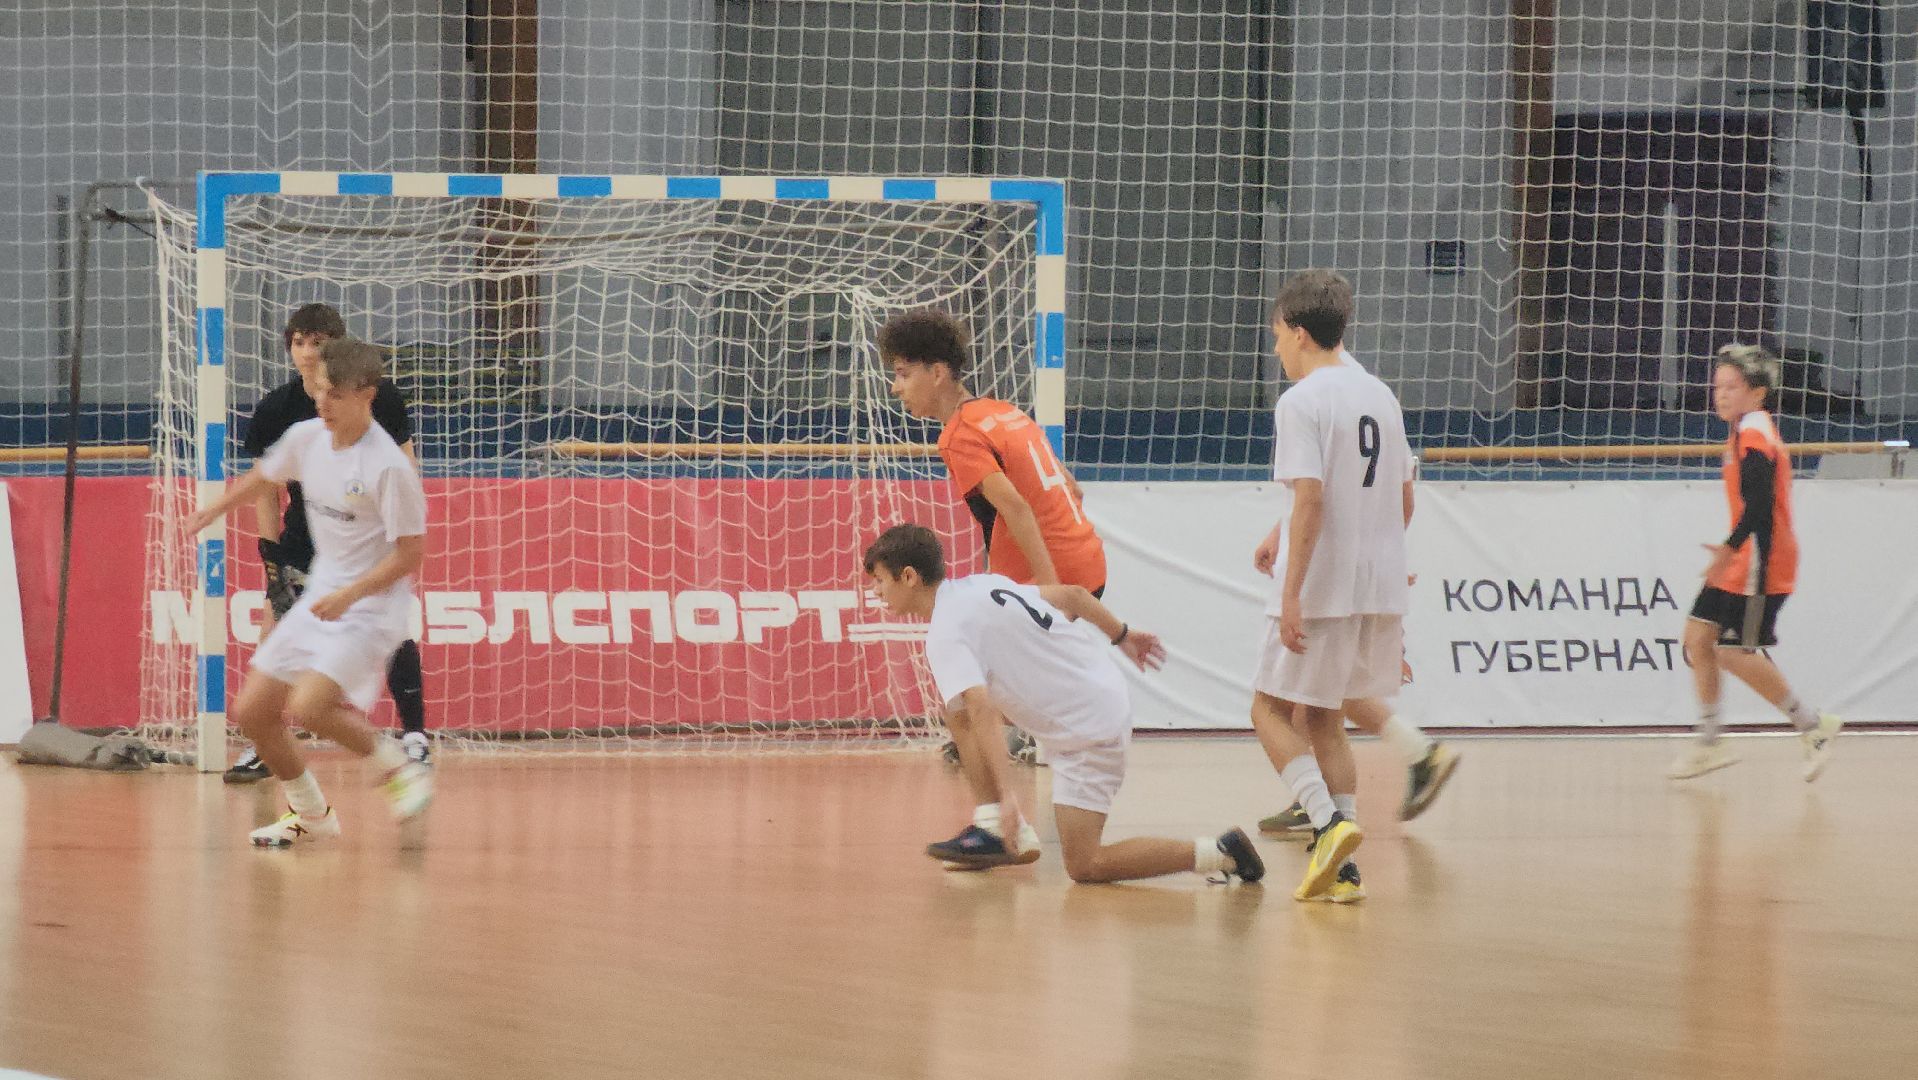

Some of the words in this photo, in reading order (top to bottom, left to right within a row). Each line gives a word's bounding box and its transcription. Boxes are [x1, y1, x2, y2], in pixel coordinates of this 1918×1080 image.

[1359, 414, 1381, 488] 9
[1027, 435, 1082, 525] 4
[150, 590, 858, 644] МОБЛСПОРТ
[990, 588, 1053, 631] 2
[1443, 577, 1679, 616] КОМАНДА
[1450, 637, 1772, 674] ГУБЕРНАТ
